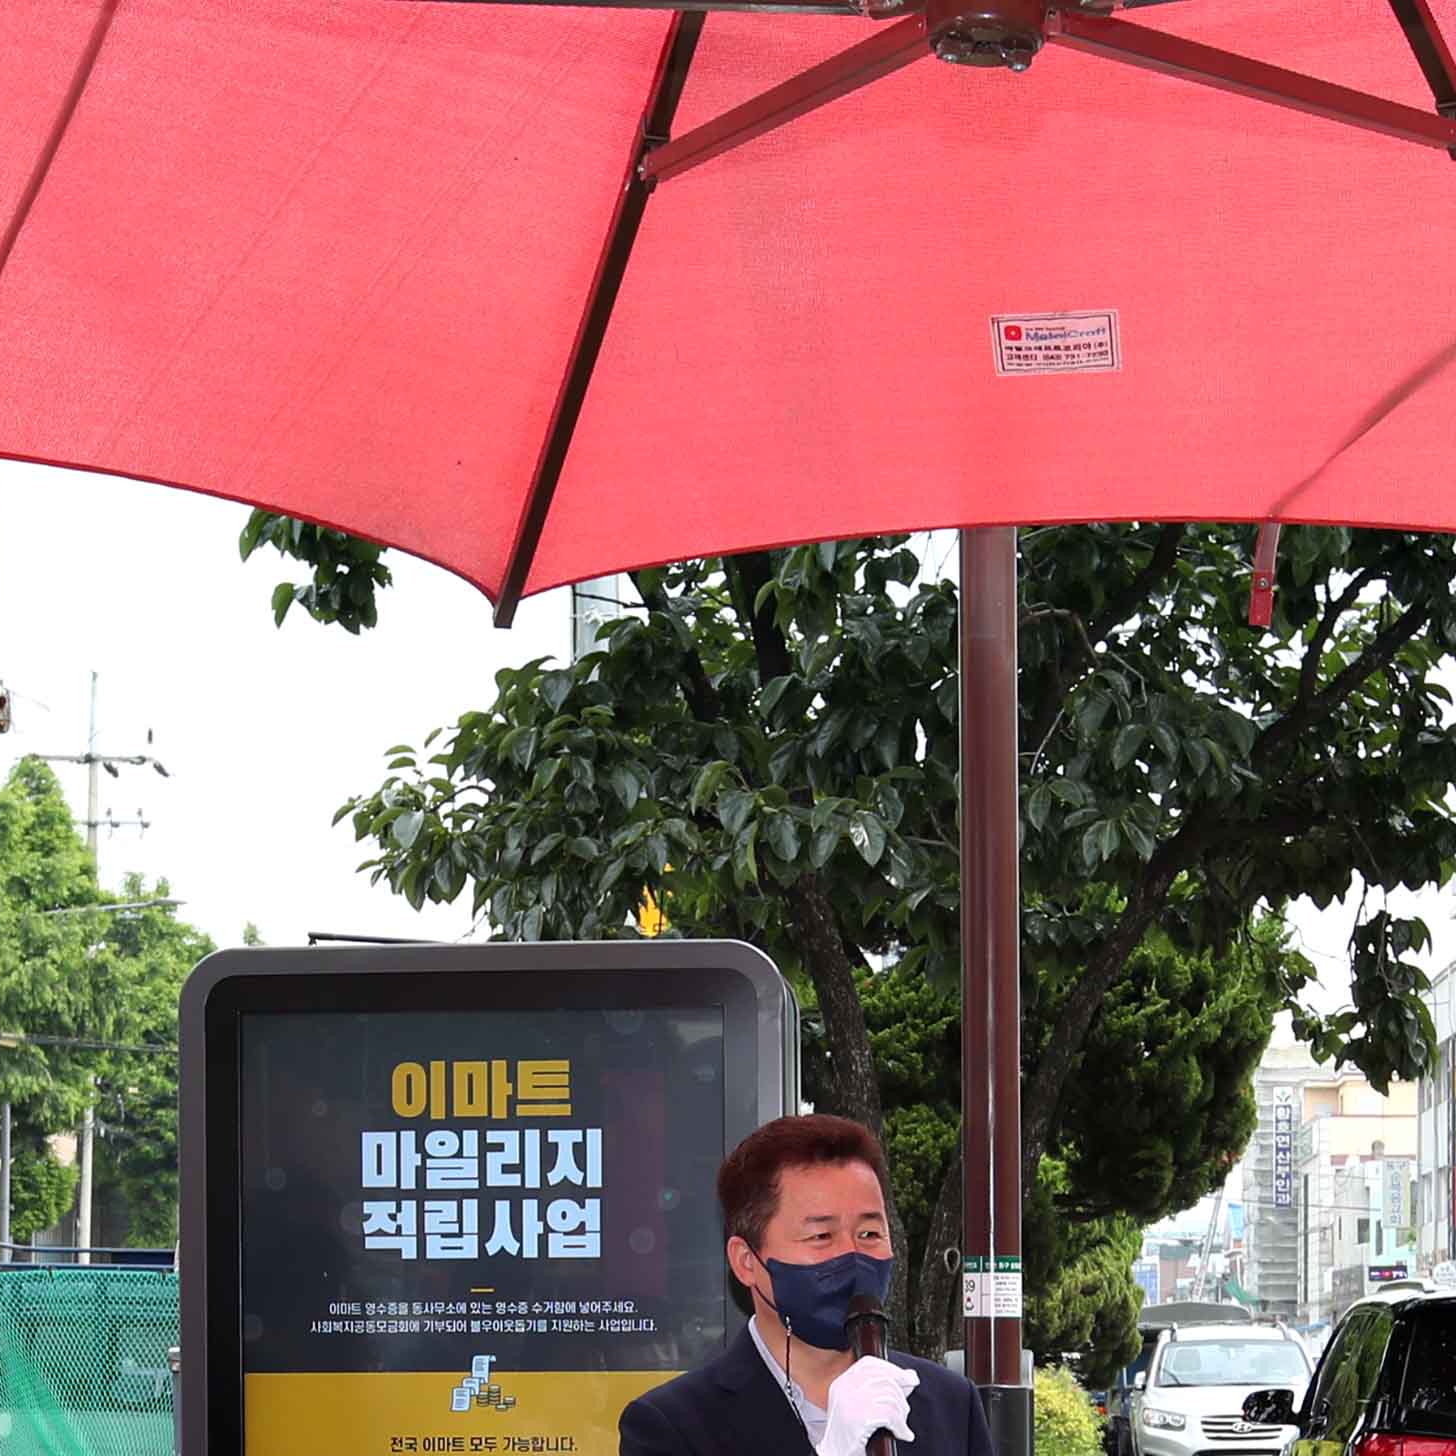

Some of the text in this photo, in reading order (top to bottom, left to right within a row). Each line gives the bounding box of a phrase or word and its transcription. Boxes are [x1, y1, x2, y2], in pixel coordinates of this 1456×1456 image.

[391, 1060, 572, 1120] 이마트
[361, 1128, 603, 1190] 마일리지
[362, 1199, 602, 1260] 적립사업
[310, 1319, 658, 1334] 사회복지공동모금회에 기부되어 불우이웃돕기를 지원하는 사업입니다.
[329, 1301, 639, 1316] 이마트 영수증을 동사무소에 있는 영수증 수거함에 넣어주세요.
[390, 1436, 578, 1453] 전국 이마트 모두 가능합니다.
